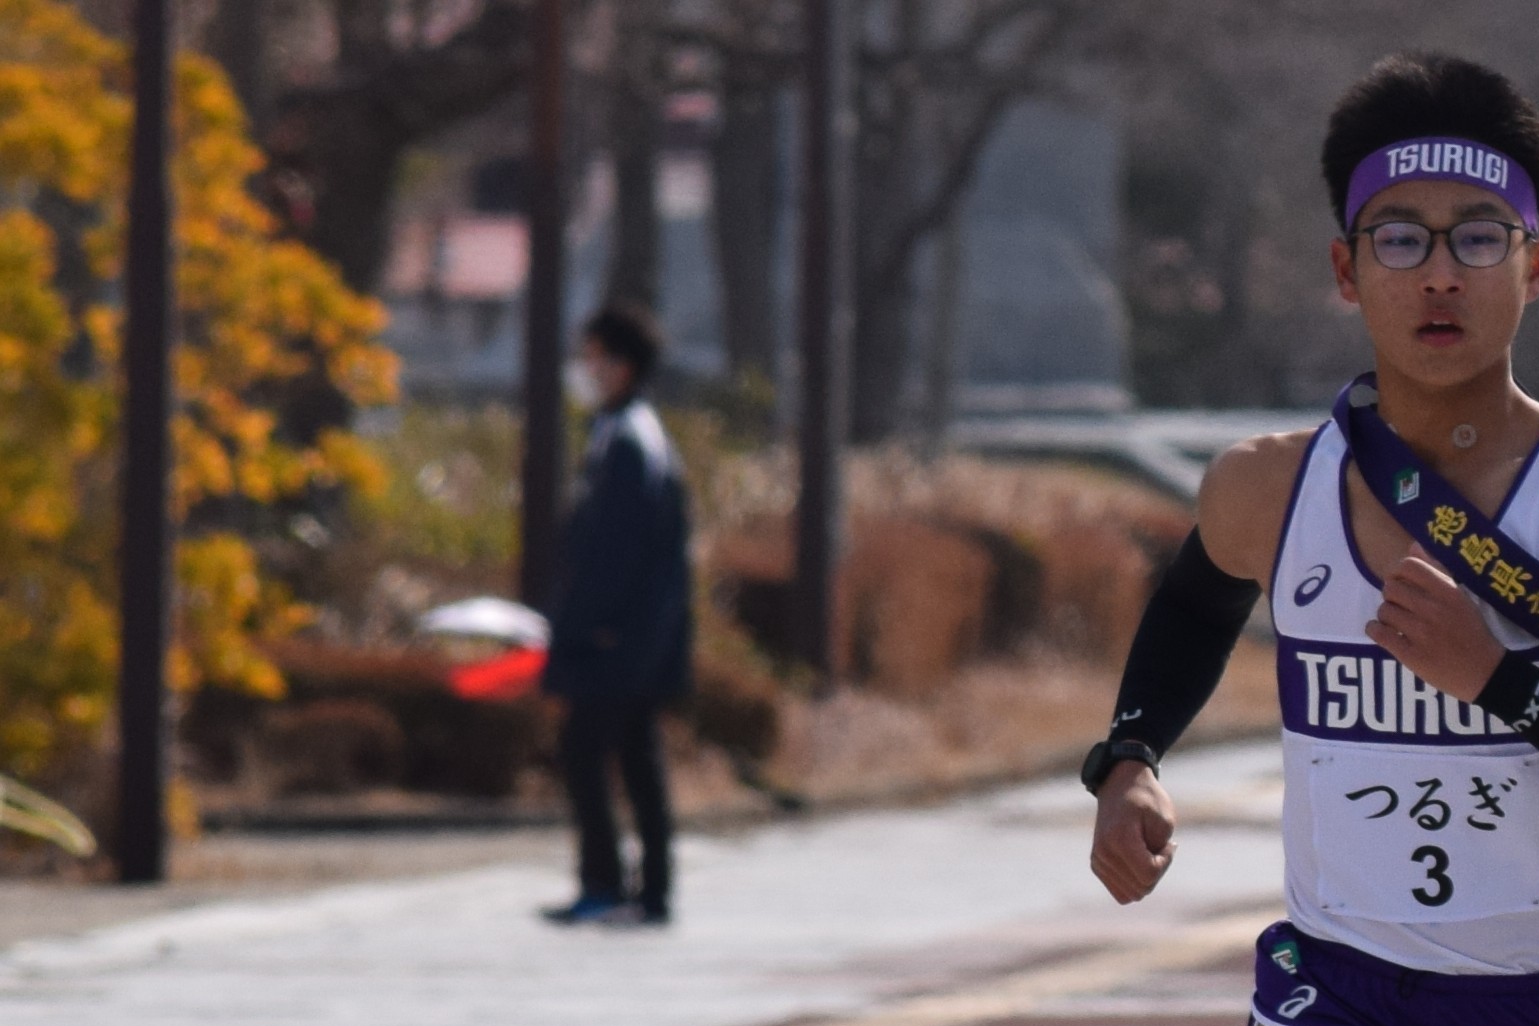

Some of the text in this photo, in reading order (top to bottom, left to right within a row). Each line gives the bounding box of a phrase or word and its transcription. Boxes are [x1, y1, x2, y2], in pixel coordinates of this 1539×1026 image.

[1386, 143, 1509, 190] TSURUGI
[1296, 651, 1516, 735] TSURU
[1345, 776, 1518, 831] つるぎ
[1411, 845, 1454, 907] 3
